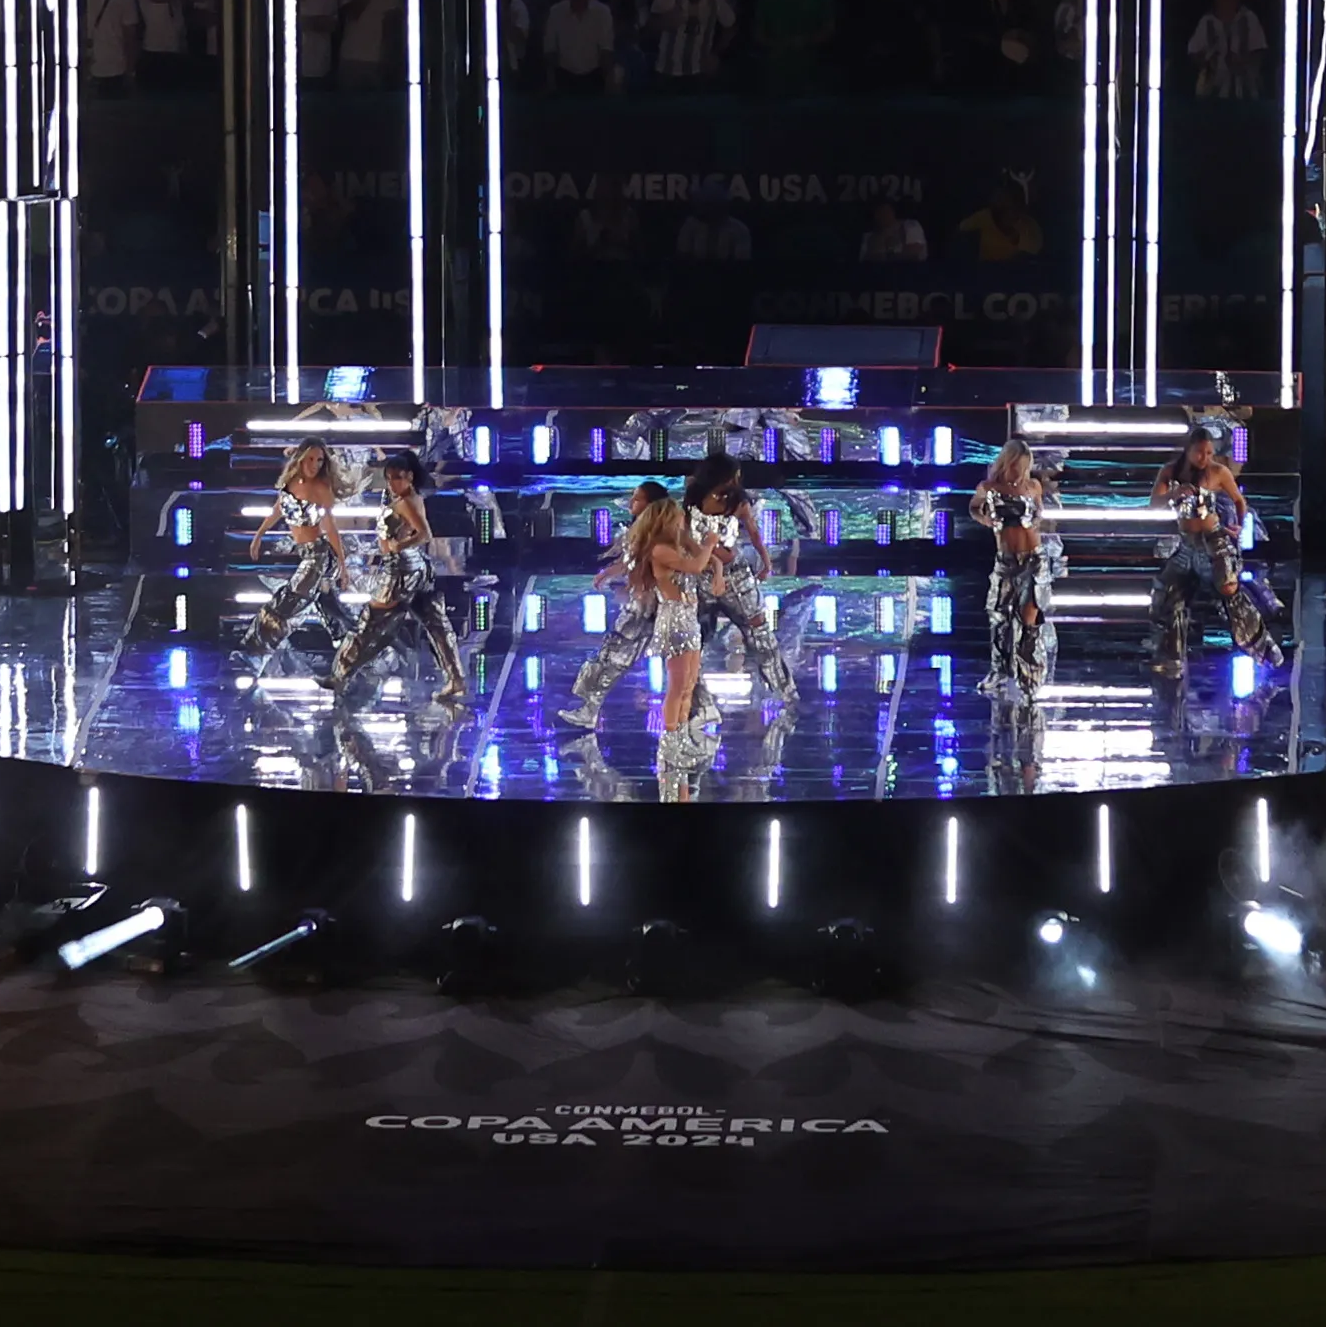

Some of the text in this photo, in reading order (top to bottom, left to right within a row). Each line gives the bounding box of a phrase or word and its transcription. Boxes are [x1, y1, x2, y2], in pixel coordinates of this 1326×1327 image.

[503, 171, 580, 200] OPA
[759, 173, 828, 204] USA
[87, 286, 178, 315] OPA
[554, 1104, 711, 1116] CONMEBOL
[364, 1114, 890, 1134] COPA AMERICA
[491, 1132, 756, 1148] USA 2024
